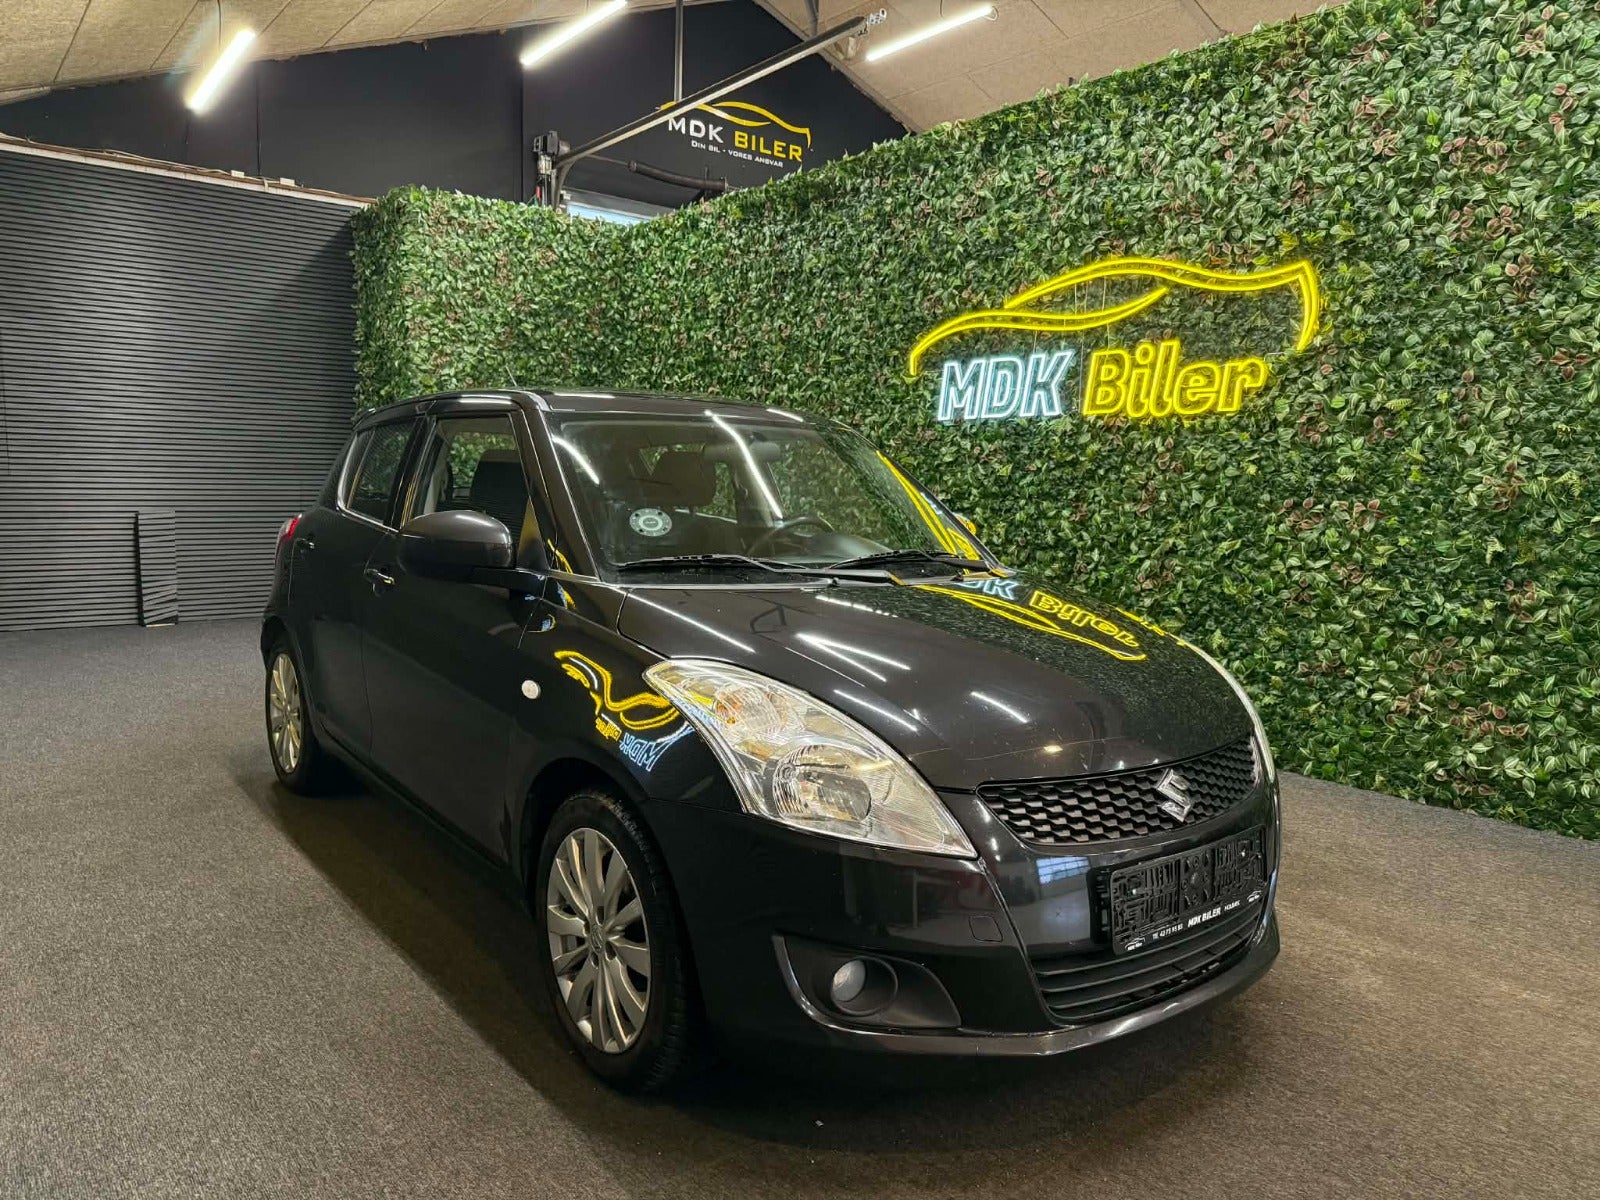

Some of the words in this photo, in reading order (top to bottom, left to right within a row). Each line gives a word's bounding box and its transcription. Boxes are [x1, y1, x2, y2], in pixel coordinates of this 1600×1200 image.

[668, 117, 724, 144] MDK
[734, 130, 802, 162] BILER
[728, 149, 753, 160] VORES
[755, 155, 784, 168] ANSVAR
[937, 349, 1074, 421] MDK
[1083, 339, 1268, 419] Biler
[1202, 907, 1221, 922] BILER
